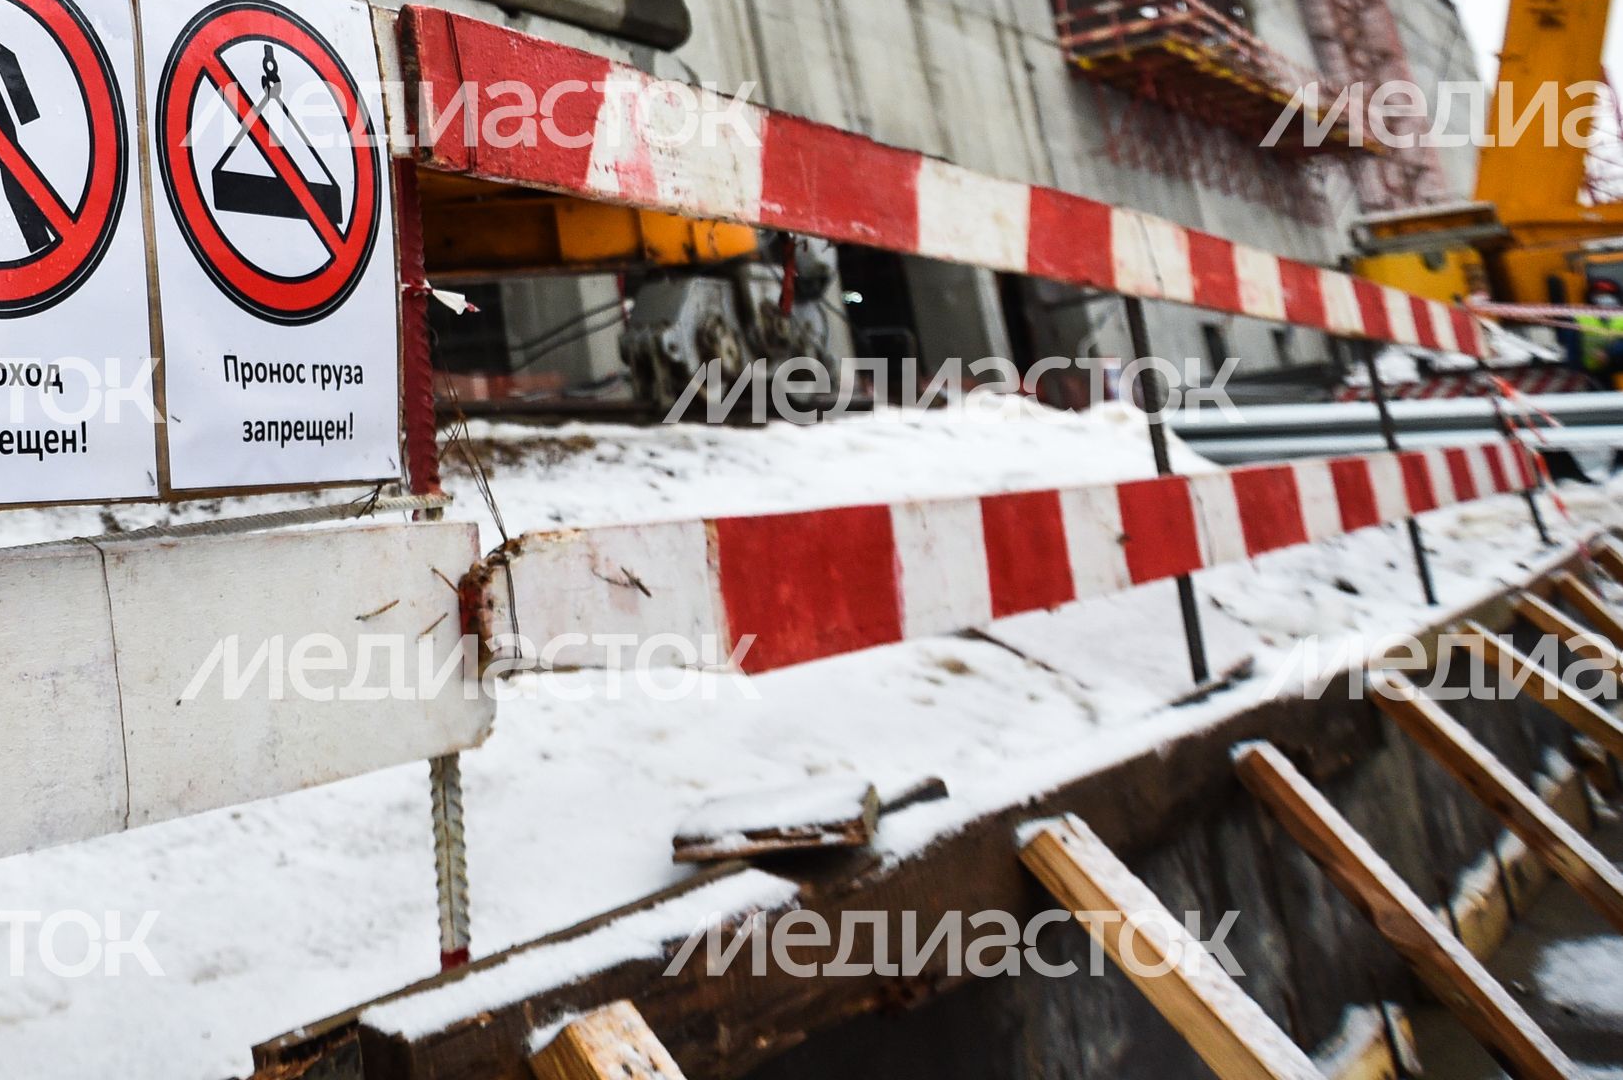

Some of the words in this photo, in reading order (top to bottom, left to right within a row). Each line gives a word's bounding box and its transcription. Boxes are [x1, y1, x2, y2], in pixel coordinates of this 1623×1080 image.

[223, 354, 306, 389] Пронос
[312, 365, 364, 393] груза
[242, 412, 354, 447] запрещен!
